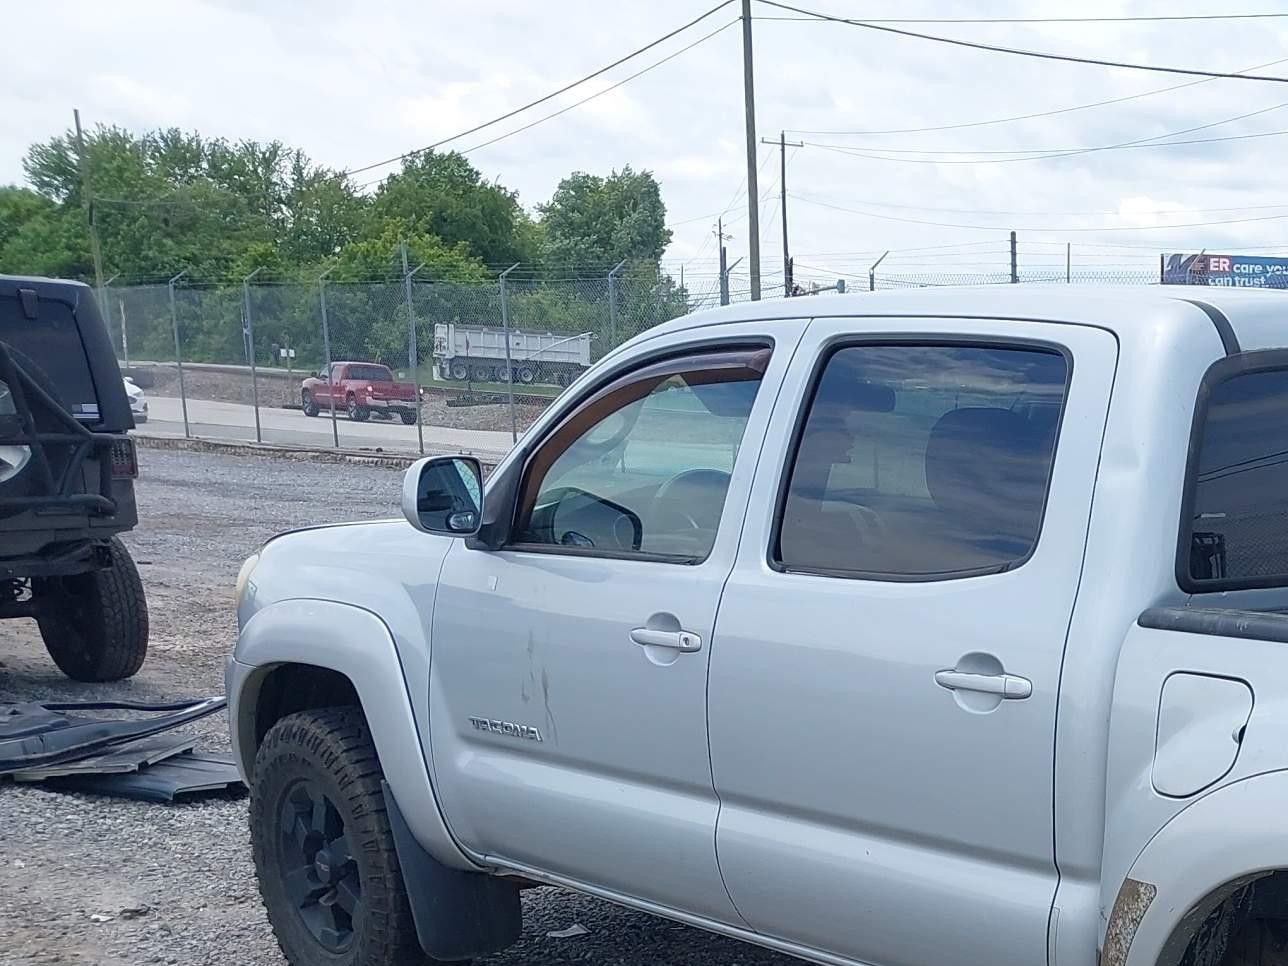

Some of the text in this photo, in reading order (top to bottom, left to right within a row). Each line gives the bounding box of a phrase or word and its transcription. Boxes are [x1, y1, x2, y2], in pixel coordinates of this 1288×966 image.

[1209, 258, 1230, 272] ER
[1233, 263, 1263, 273] care
[1208, 276, 1232, 286] can
[468, 715, 543, 743] TACOMA
